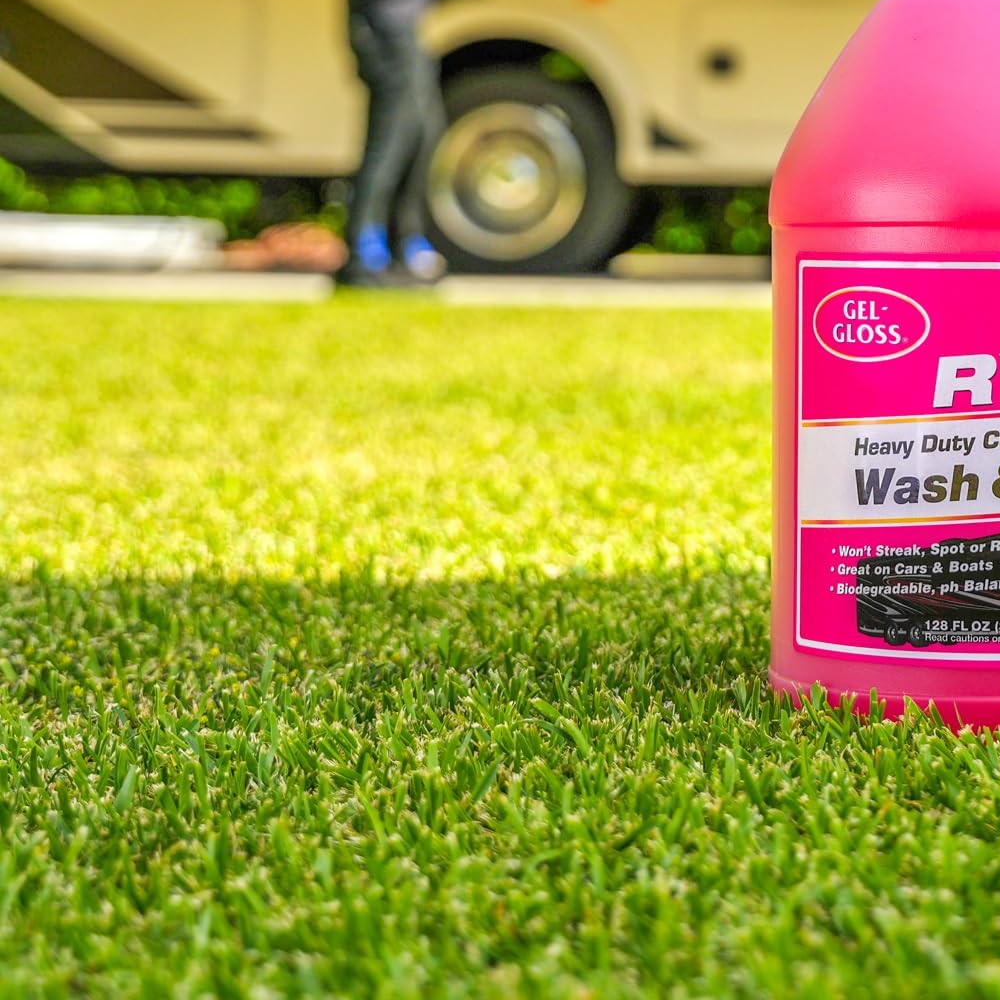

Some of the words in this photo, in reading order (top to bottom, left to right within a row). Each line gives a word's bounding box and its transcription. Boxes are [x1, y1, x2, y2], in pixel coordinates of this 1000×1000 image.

[843, 300, 888, 320] GEL-
[854, 434, 914, 459] Heavy
[921, 432, 975, 456] Duty
[855, 464, 980, 506] Wash
[838, 545, 872, 557] Won't
[875, 544, 926, 558] Streak,
[930, 543, 965, 557] Spot
[969, 543, 986, 553] or
[837, 563, 871, 575] Great
[874, 565, 891, 575] on
[894, 562, 927, 575] Cars
[931, 561, 944, 574] &
[948, 559, 993, 572] Boats
[838, 583, 935, 596] Biodegradable,
[941, 581, 959, 593] ph
[924, 619, 948, 631] 128
[953, 620, 969, 631] FL
[971, 620, 989, 632] OZ
[924, 633, 948, 642] Read
[950, 633, 990, 643] cautions
